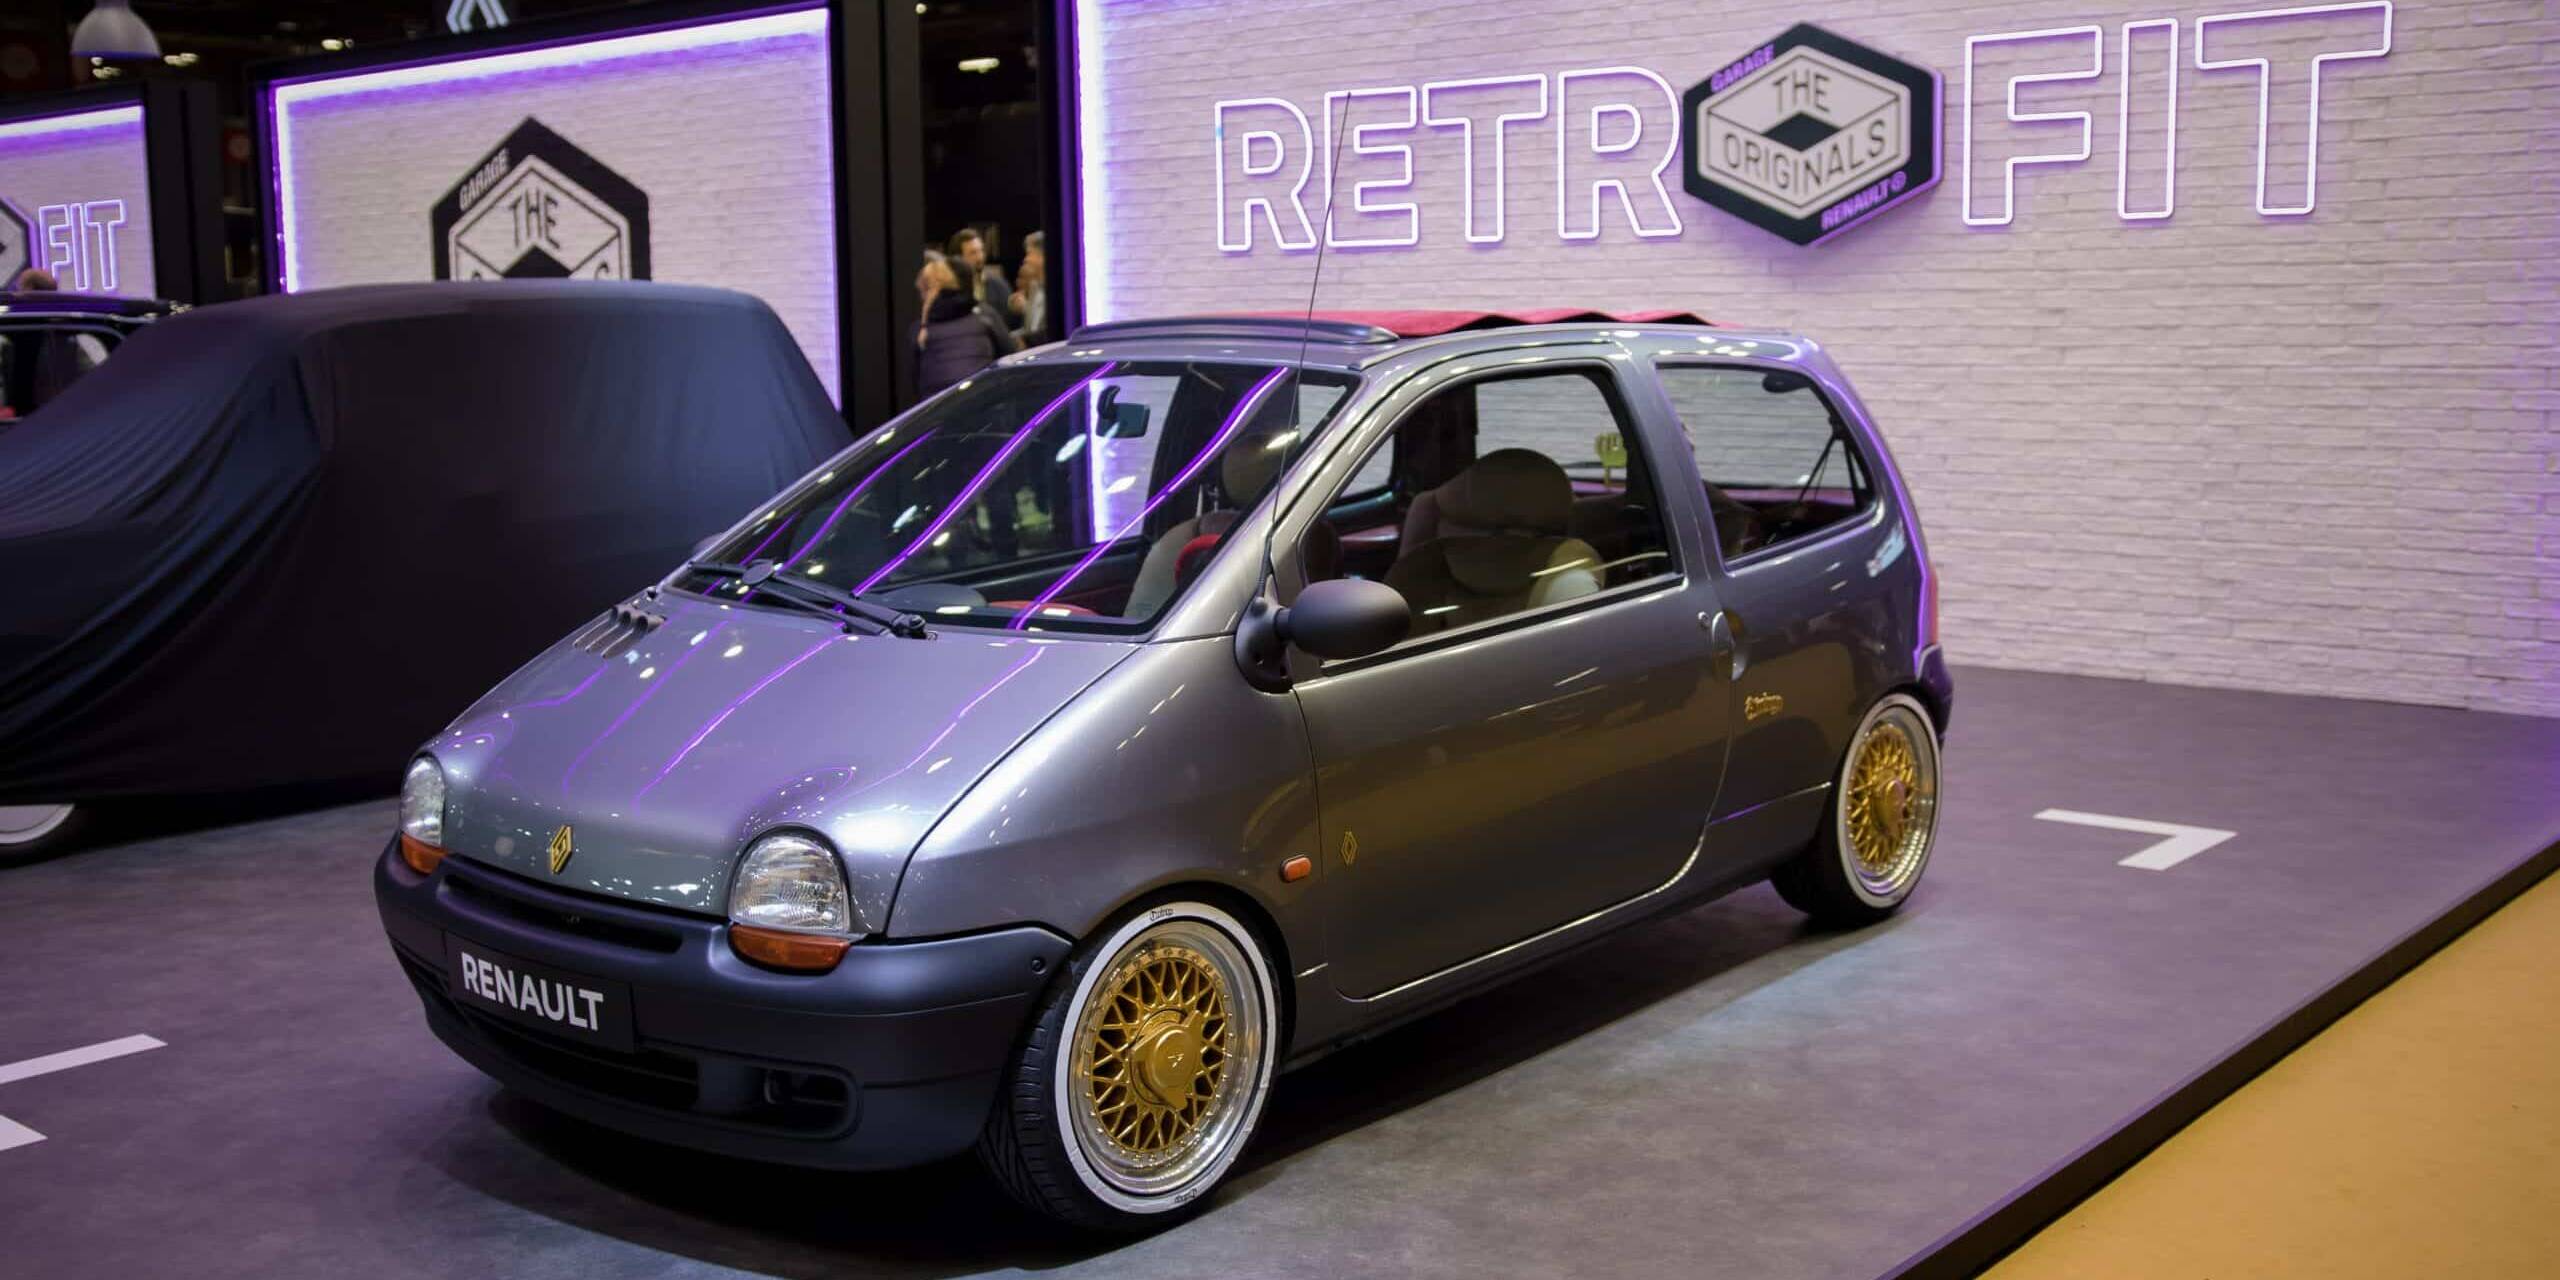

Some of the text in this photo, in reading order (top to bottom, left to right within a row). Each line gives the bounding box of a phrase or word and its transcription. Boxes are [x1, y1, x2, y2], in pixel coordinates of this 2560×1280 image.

[1710, 43, 1775, 93] GARAGE
[1772, 69, 1831, 114] THE
[1962, 1, 2393, 226] FIT
[458, 148, 510, 213] GARAGE
[1723, 118, 1887, 197] ORIGINALS
[38, 199, 126, 291] FIT
[507, 187, 561, 250] THE
[461, 952, 604, 1032] RENAULT
